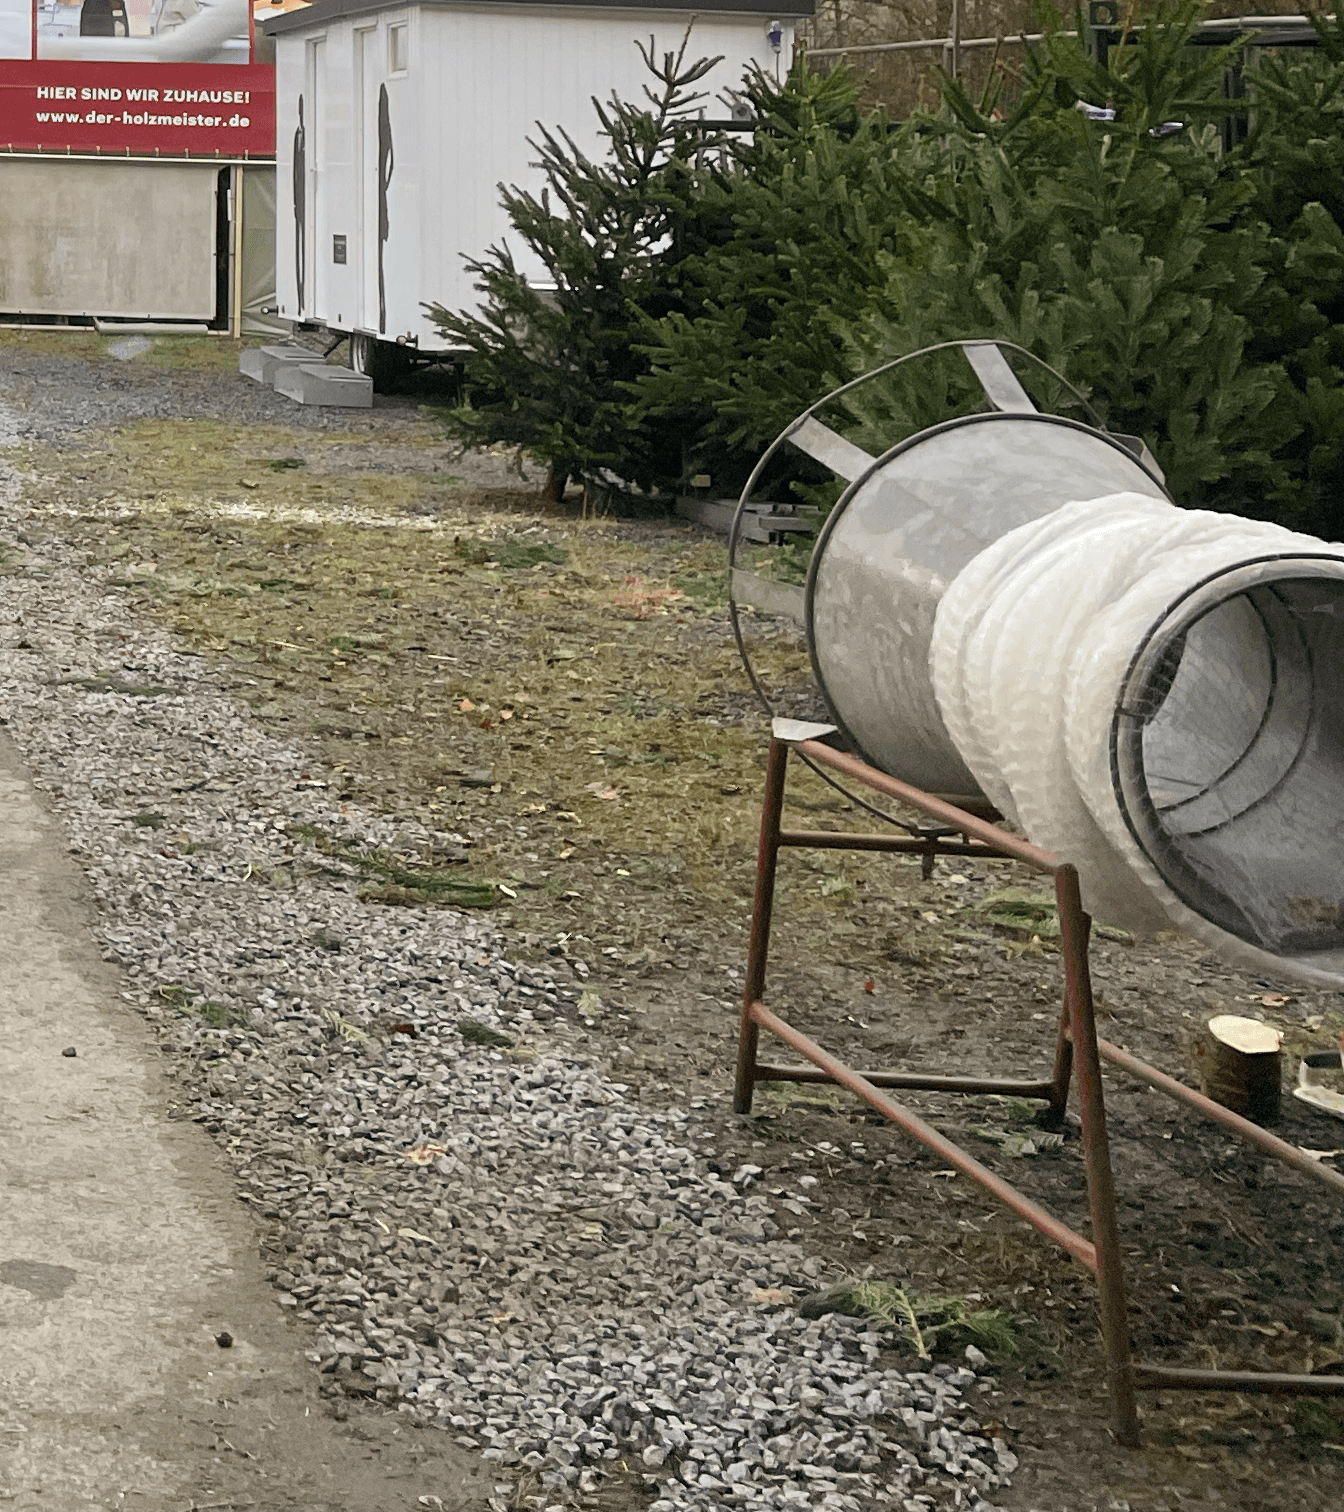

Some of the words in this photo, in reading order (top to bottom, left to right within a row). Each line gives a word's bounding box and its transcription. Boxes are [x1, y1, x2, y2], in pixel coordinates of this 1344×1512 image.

[36, 86, 77, 100] HIER
[81, 87, 122, 101] SIND
[126, 89, 159, 102] WIR
[163, 90, 250, 103] ZUHAUSE!
[36, 110, 250, 127] www.der-holzmeister.de
